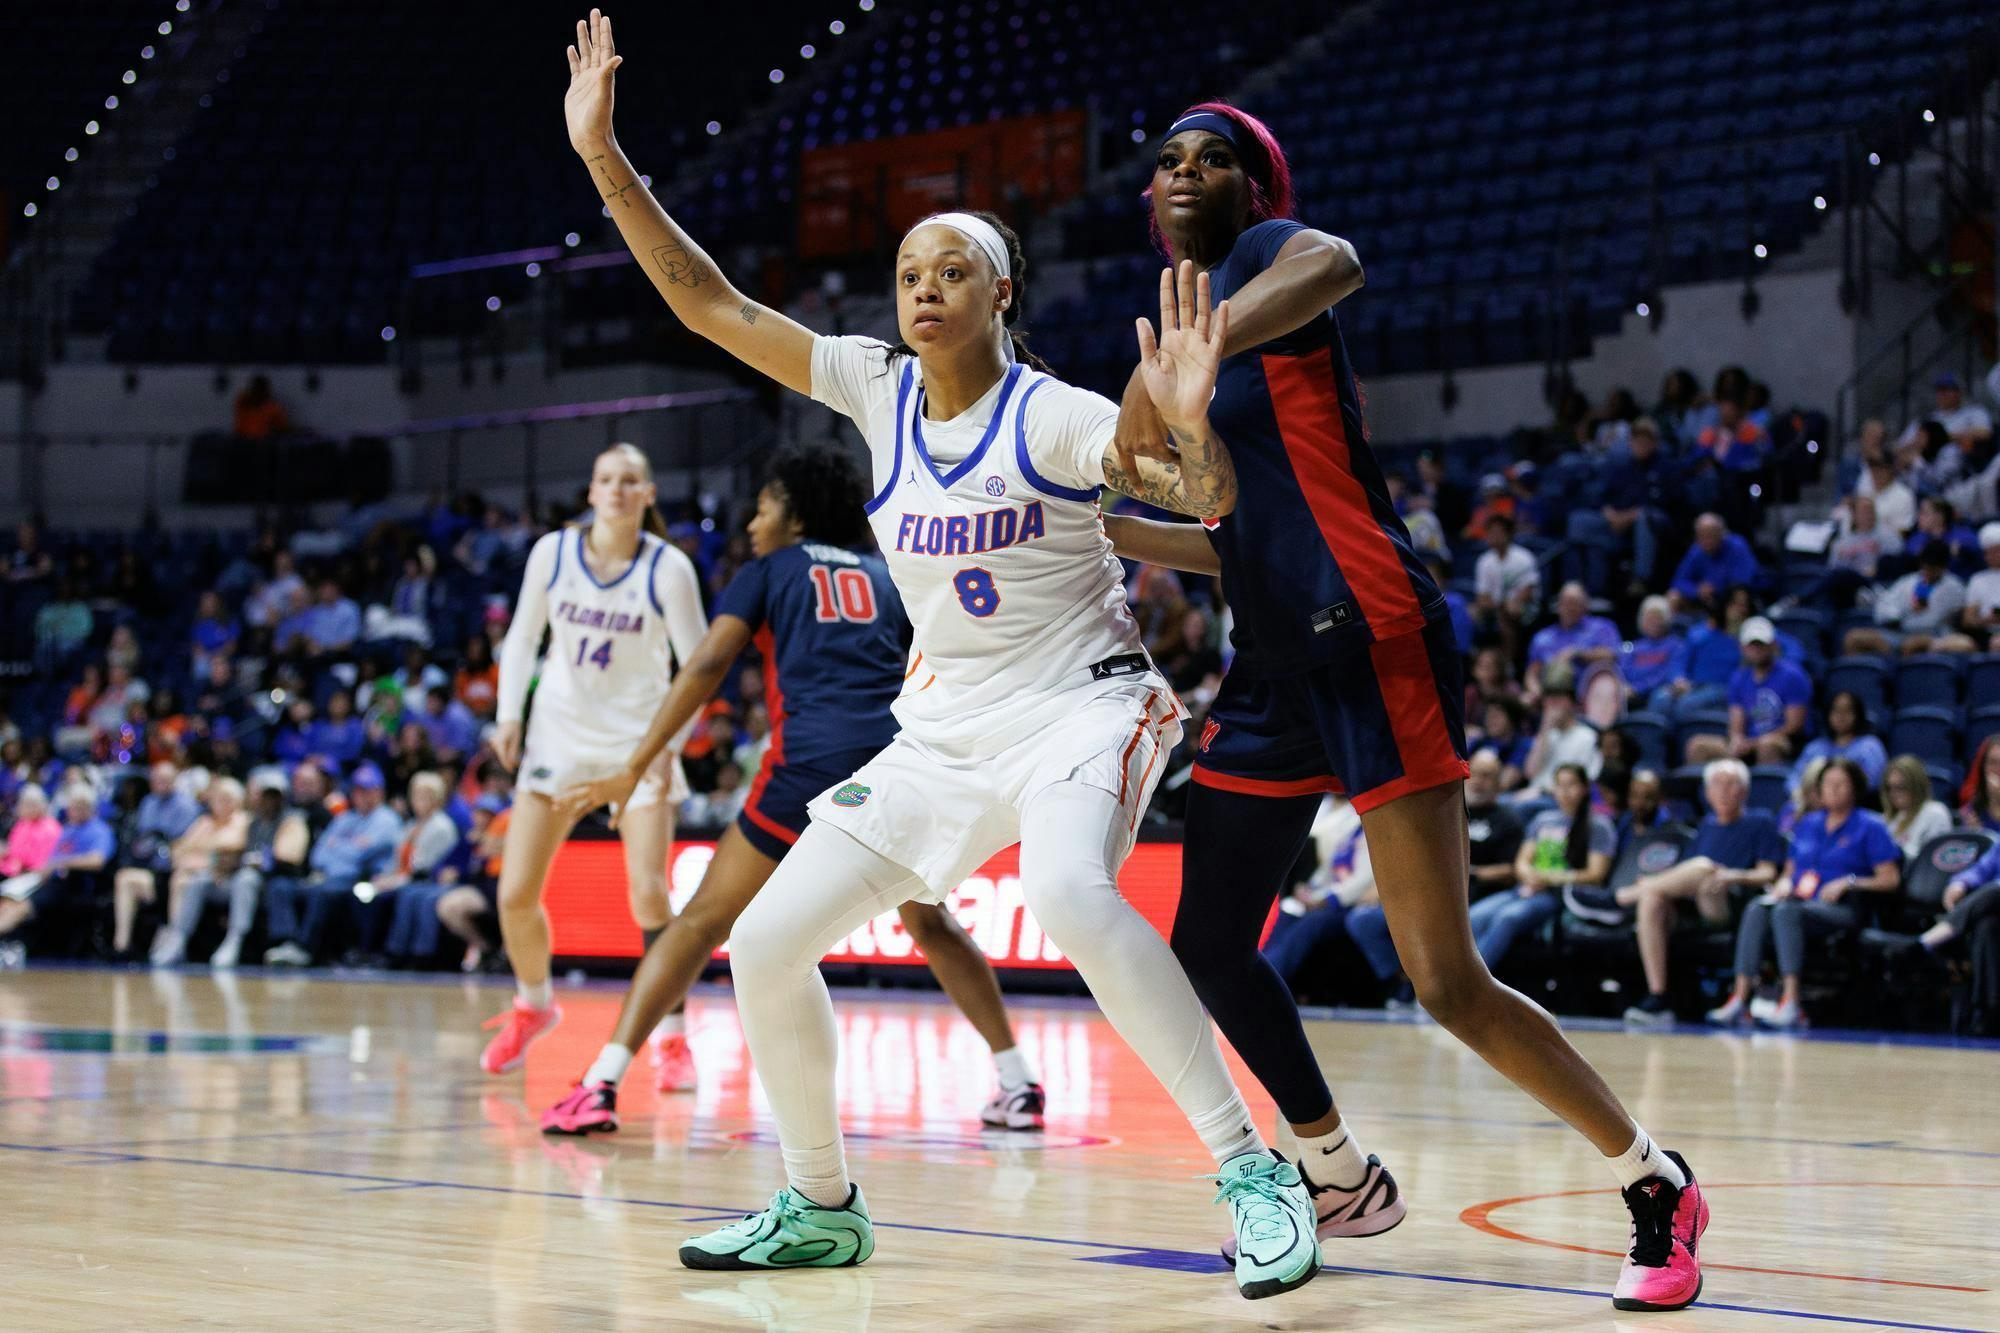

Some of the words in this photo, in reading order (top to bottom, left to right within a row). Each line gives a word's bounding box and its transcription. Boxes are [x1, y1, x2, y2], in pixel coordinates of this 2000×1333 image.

[894, 500, 1045, 557] FLORIDA
[808, 564, 878, 624] 10
[953, 566, 1001, 618] 8
[557, 601, 643, 633] FLORIDA
[1335, 608, 1346, 620] M
[576, 637, 613, 670] 14
